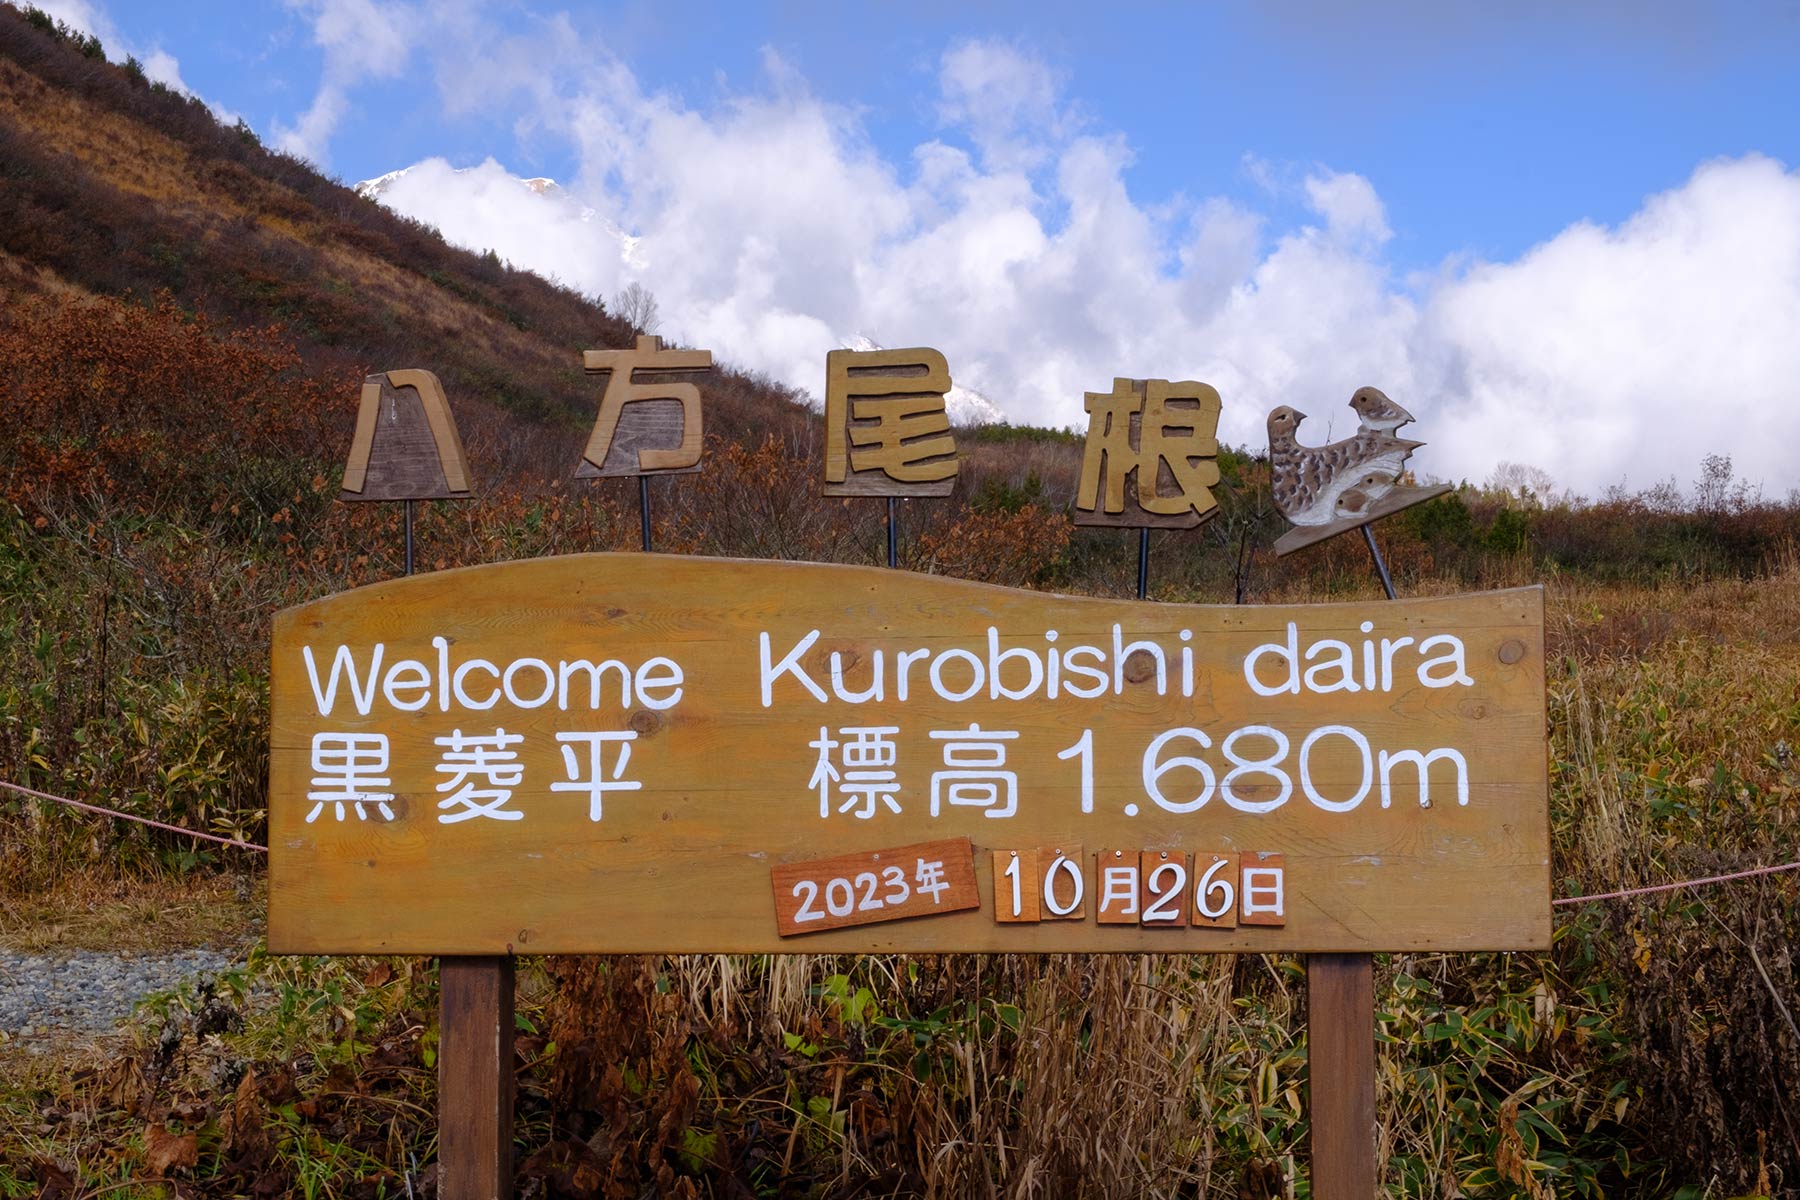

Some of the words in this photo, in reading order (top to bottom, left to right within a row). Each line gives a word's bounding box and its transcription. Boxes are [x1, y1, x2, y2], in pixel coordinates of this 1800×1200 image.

[342, 335, 1222, 515] 八方尾根
[303, 636, 684, 717] Welcome
[760, 626, 1193, 708] Kurobishi
[1244, 622, 1475, 697] daira
[305, 728, 643, 824] 黒菱平
[808, 723, 1019, 819] 標高
[1057, 725, 1469, 818] 1.680m
[792, 857, 950, 924] 2023年
